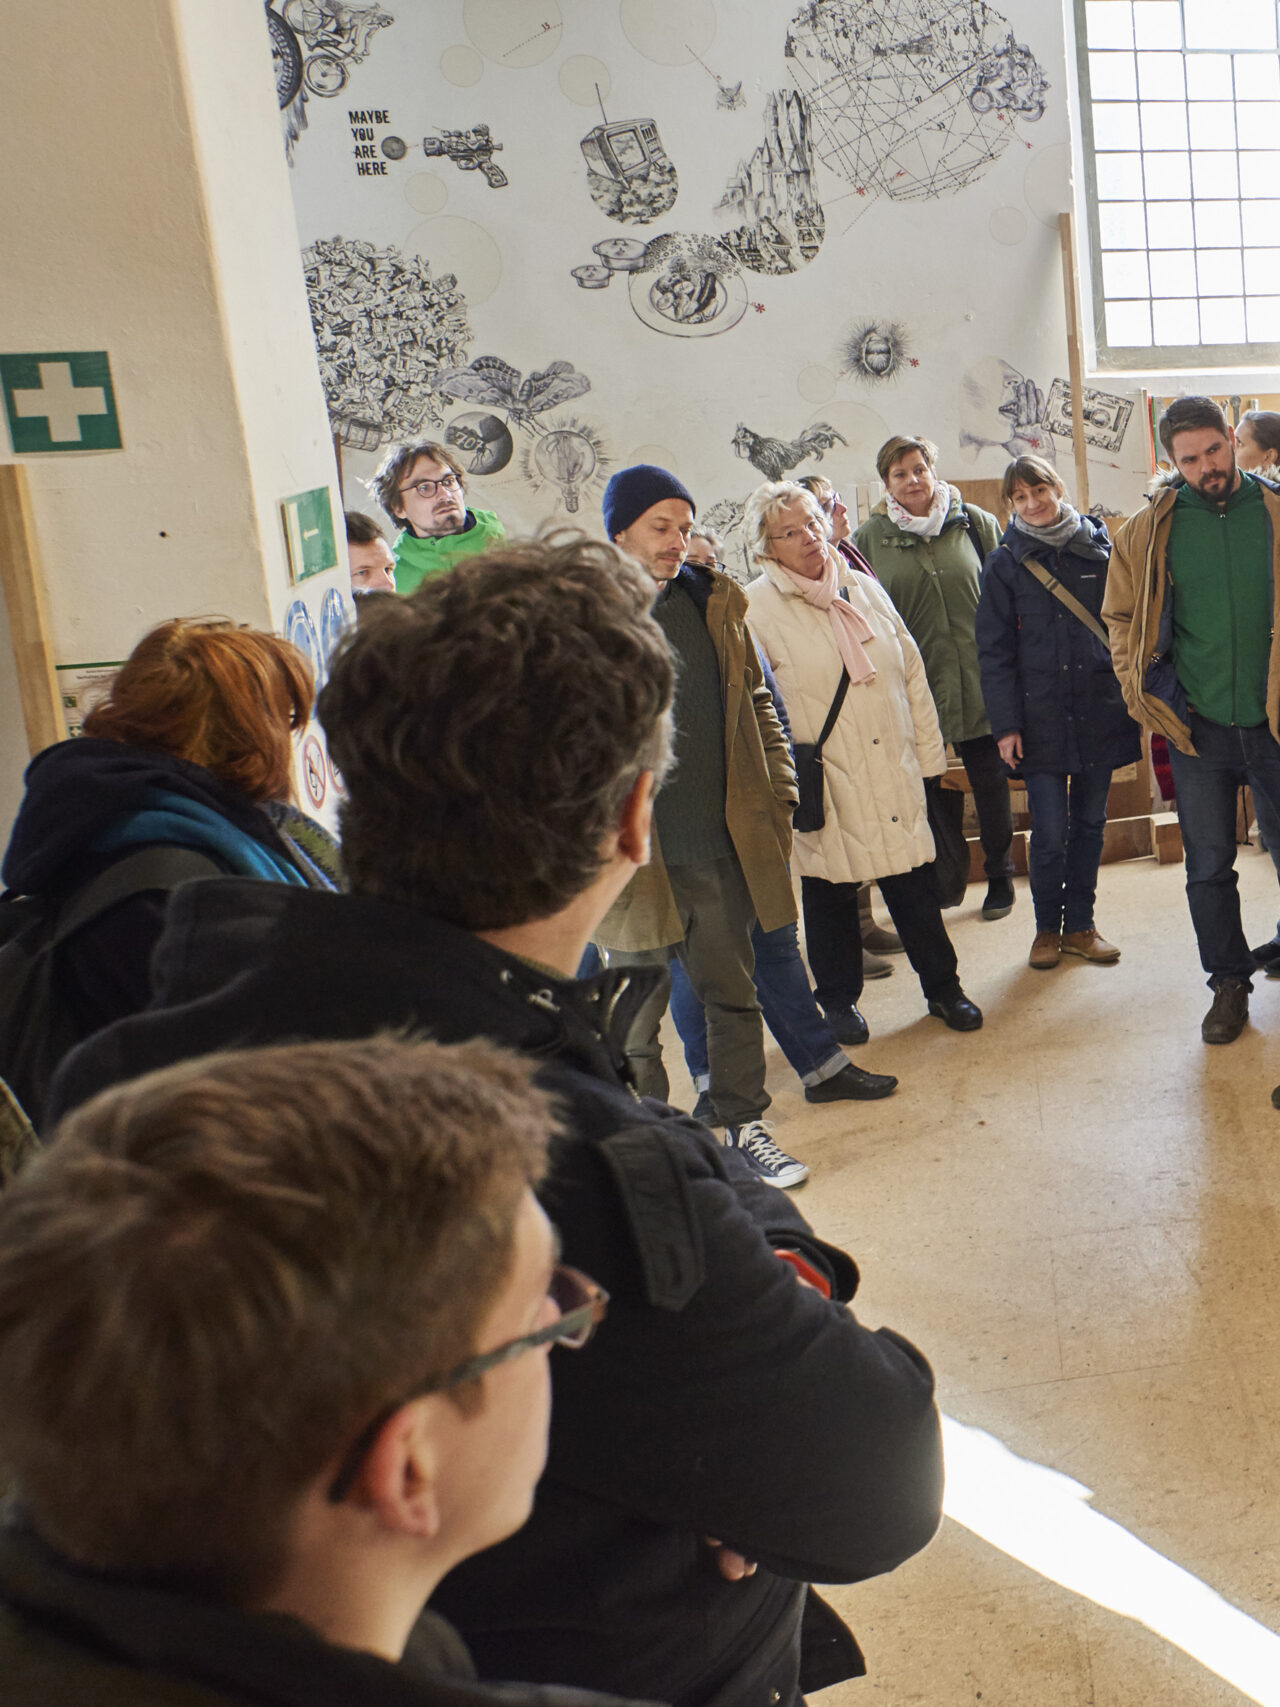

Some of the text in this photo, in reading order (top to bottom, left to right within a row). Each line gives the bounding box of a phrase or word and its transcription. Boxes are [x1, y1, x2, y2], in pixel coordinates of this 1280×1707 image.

[348, 110, 391, 124] MAYBE
[351, 128, 375, 141] YOU
[354, 145, 377, 158] ARE
[357, 162, 388, 176] HERE
